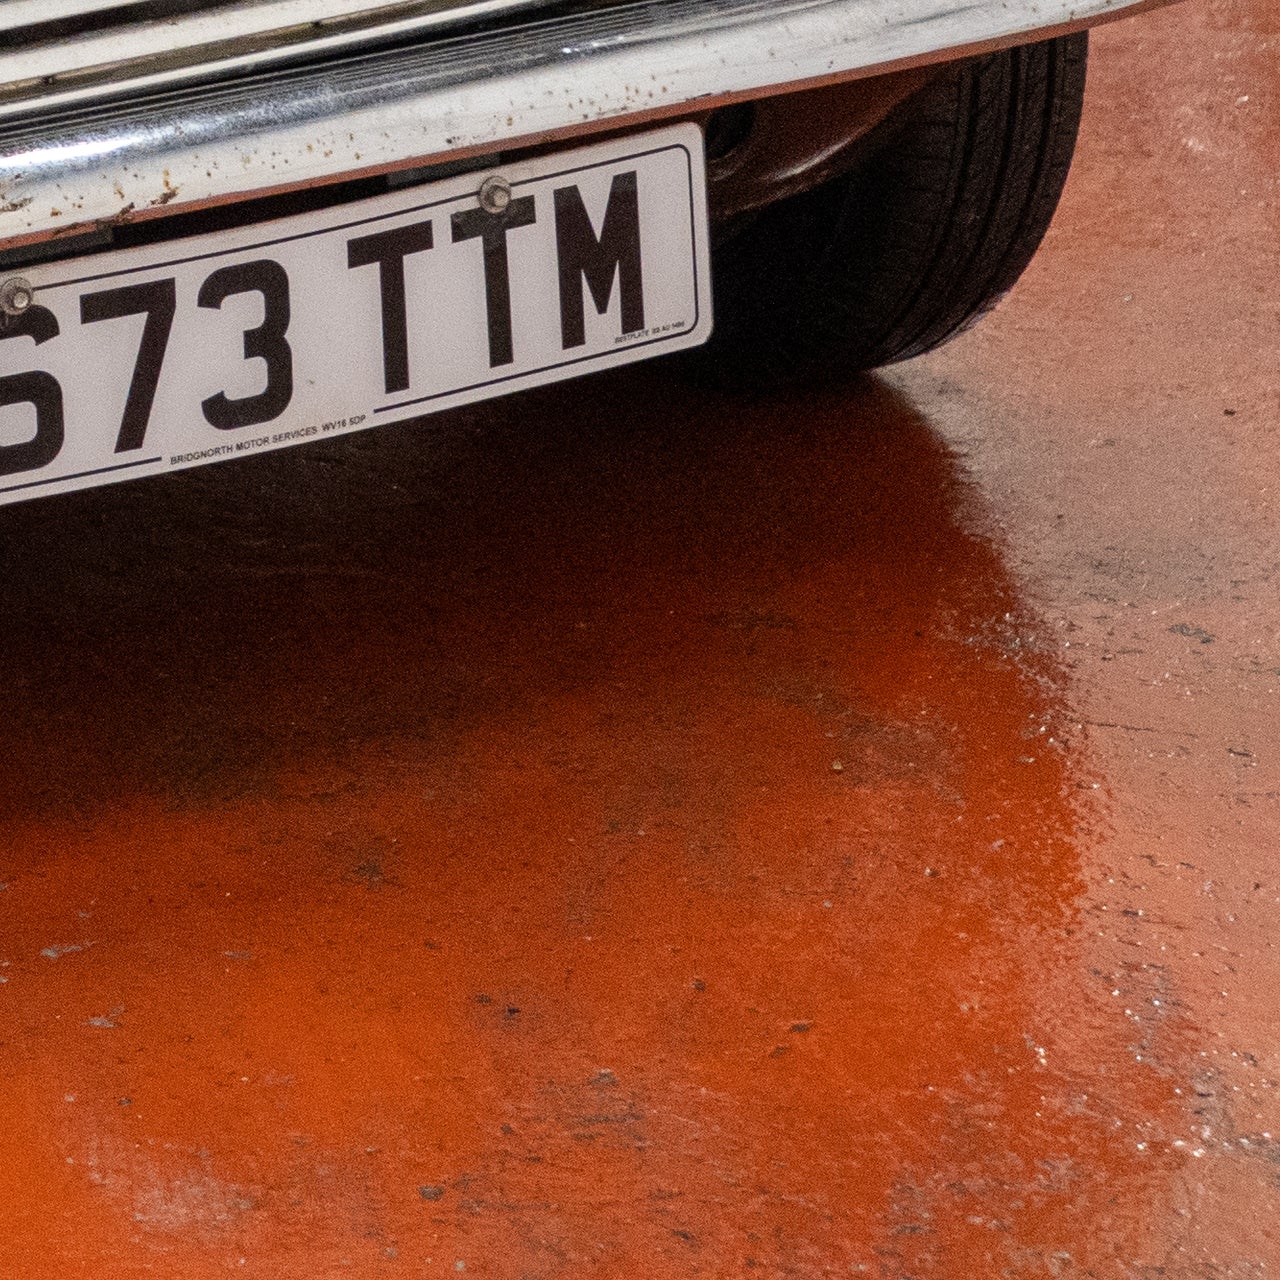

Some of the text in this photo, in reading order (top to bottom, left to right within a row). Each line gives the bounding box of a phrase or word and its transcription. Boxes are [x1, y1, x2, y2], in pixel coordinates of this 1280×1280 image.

[346, 170, 645, 395] TTM
[170, 443, 234, 465] BRIDGNORTH
[235, 436, 270, 452] MOTOR
[272, 425, 318, 443] SERVICES
[321, 419, 347, 432] WV16
